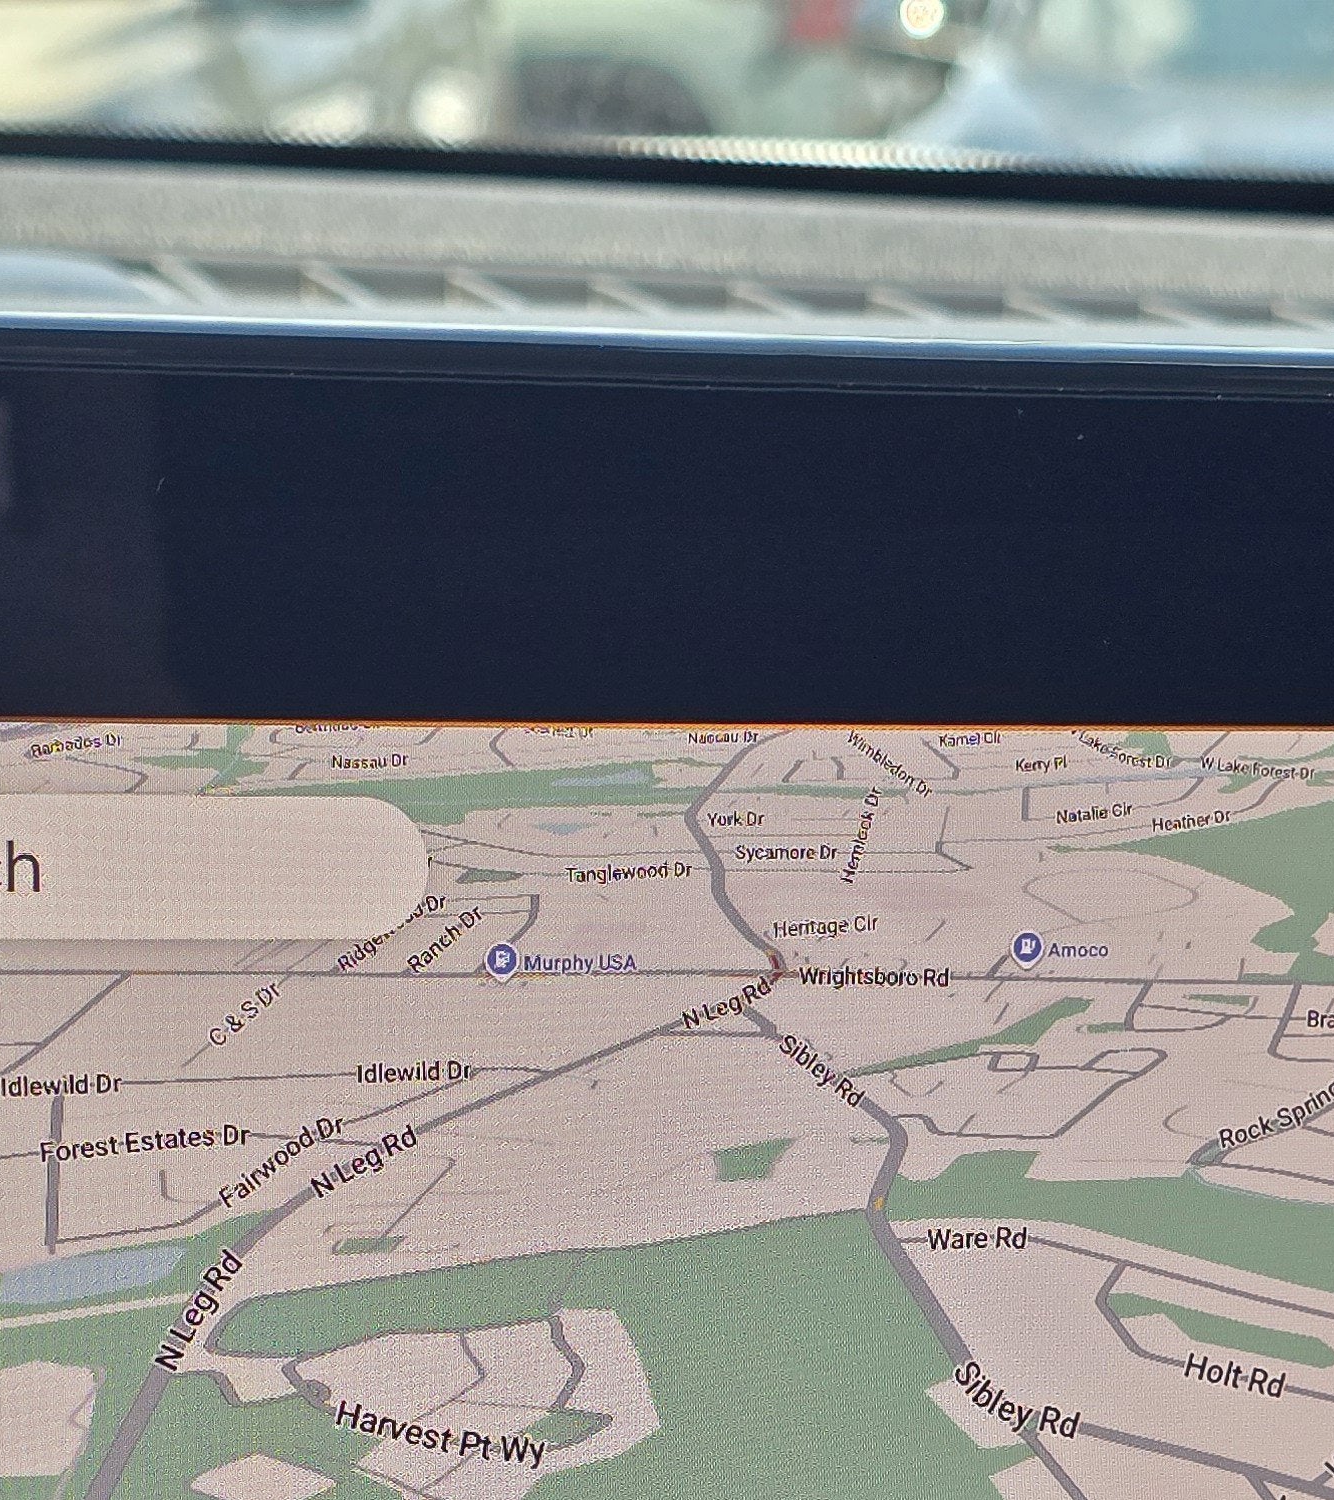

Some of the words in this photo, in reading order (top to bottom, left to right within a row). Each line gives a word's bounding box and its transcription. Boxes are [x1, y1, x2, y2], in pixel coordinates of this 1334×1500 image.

[332, 754, 387, 770] Nassau
[392, 753, 409, 768] Dr
[1217, 757, 1249, 774] Lake
[1253, 761, 1298, 780] Forest
[1300, 768, 1315, 780] Dr
[708, 811, 742, 827] York
[747, 811, 765, 826] Dr
[1152, 814, 1211, 833] Heather
[1214, 810, 1231, 824] Dr
[735, 845, 816, 863] Sycamore
[820, 844, 838, 860] Dr
[567, 864, 668, 885] Tanglewood
[674, 861, 692, 878] Dr
[407, 923, 462, 973] Ranch
[458, 906, 482, 929] Dr
[1049, 942, 1108, 958] Amoco
[524, 955, 594, 974] Murphy
[599, 954, 636, 971] USA
[799, 965, 918, 989] Wrightsboro
[924, 968, 950, 986] Rd
[210, 1028, 227, 1047] C
[227, 1012, 245, 1033] &
[242, 1000, 259, 1018] S
[253, 982, 281, 1008] Dr
[682, 1008, 699, 1029] N
[702, 991, 742, 1020] Leg
[742, 977, 772, 1007] Rd
[357, 1061, 440, 1083] Idlewild
[447, 1062, 471, 1079] Dr
[778, 1034, 837, 1088] Sibley
[835, 1076, 865, 1108] Rd
[0, 1076, 92, 1097] Idlewild
[97, 1075, 122, 1094] Dr
[40, 1137, 117, 1162] Forest
[125, 1131, 216, 1154] Estates
[223, 1124, 250, 1146] Dr
[1219, 1115, 1272, 1149] Rock
[219, 1126, 313, 1208] Fairwood
[315, 1117, 345, 1140] Dr
[310, 1175, 336, 1199] N
[336, 1146, 384, 1182] Leg
[383, 1126, 418, 1158] Rd
[928, 1229, 988, 1251] Ware
[996, 1227, 1028, 1249] Rd
[154, 1343, 185, 1372] N
[174, 1288, 220, 1345] Leg
[203, 1249, 244, 1291] Rd
[1184, 1353, 1242, 1388] Holt
[1248, 1368, 1286, 1399] Rd
[954, 1361, 1033, 1433] Sibley
[1039, 1406, 1081, 1440] Rd
[335, 1400, 449, 1454] Harvest
[459, 1430, 491, 1461] Pt
[499, 1435, 546, 1470] Wy
